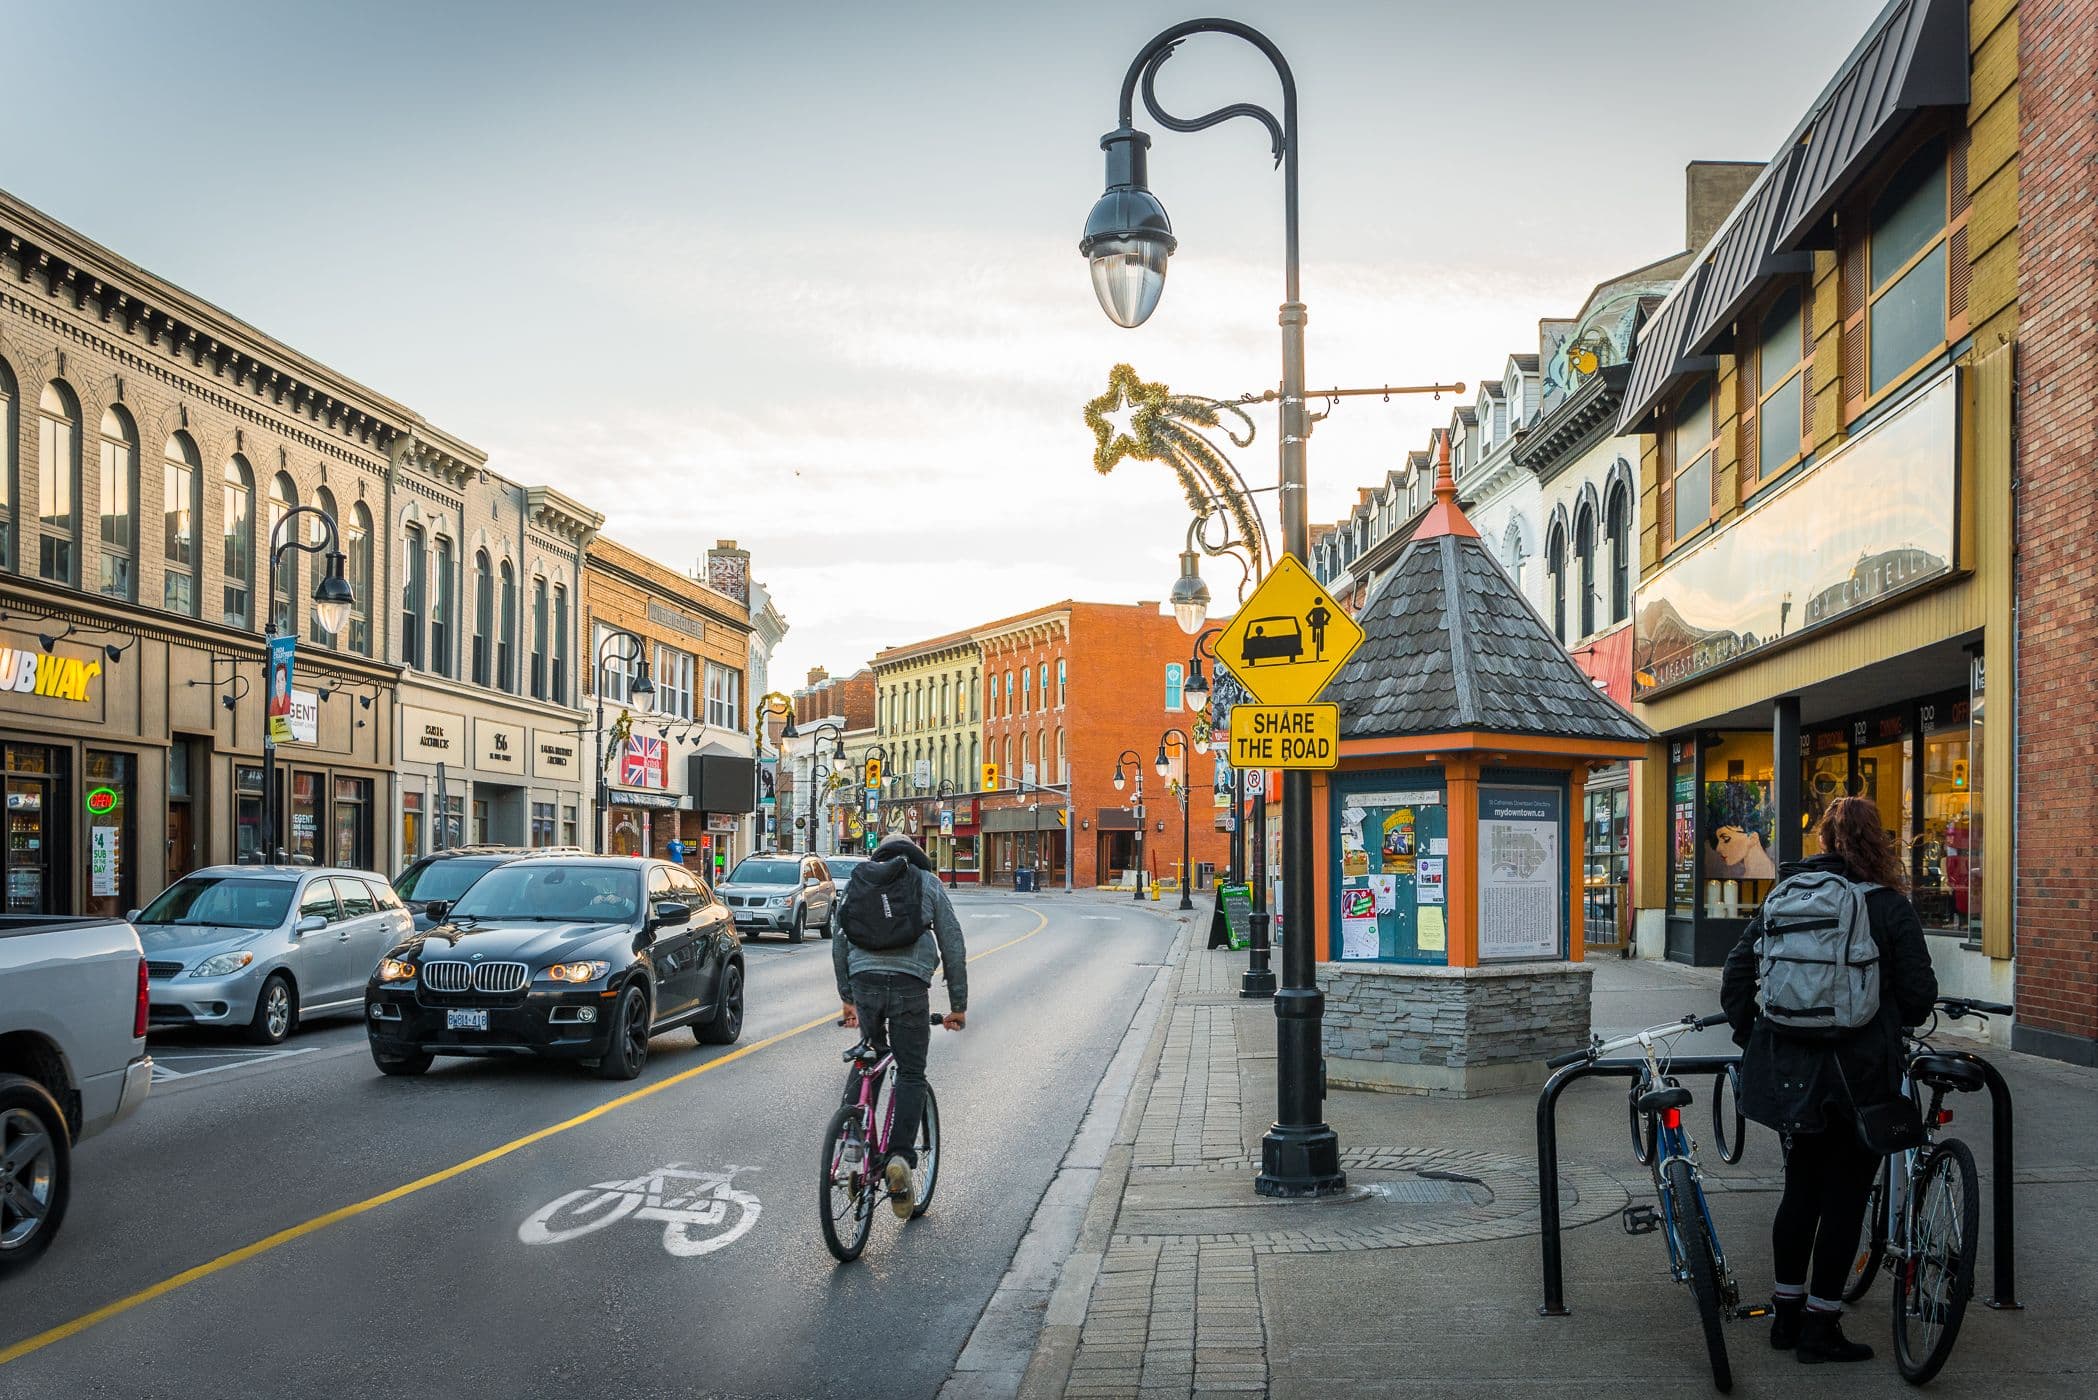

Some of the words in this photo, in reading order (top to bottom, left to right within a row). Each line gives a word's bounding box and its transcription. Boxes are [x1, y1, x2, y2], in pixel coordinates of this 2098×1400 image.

[1814, 590, 1831, 616] BY
[0, 647, 102, 702] UBWAY
[290, 703, 316, 721] GENT
[1254, 712, 1315, 734] SHARE
[1237, 738, 1273, 759] THE
[1281, 738, 1330, 759] ROAD
[90, 793, 113, 808] OPEN
[292, 814, 314, 824] EGENT
[1494, 808, 1545, 818] mydowntown.ca
[93, 850, 107, 859] SUB
[93, 865, 106, 874] DAY
